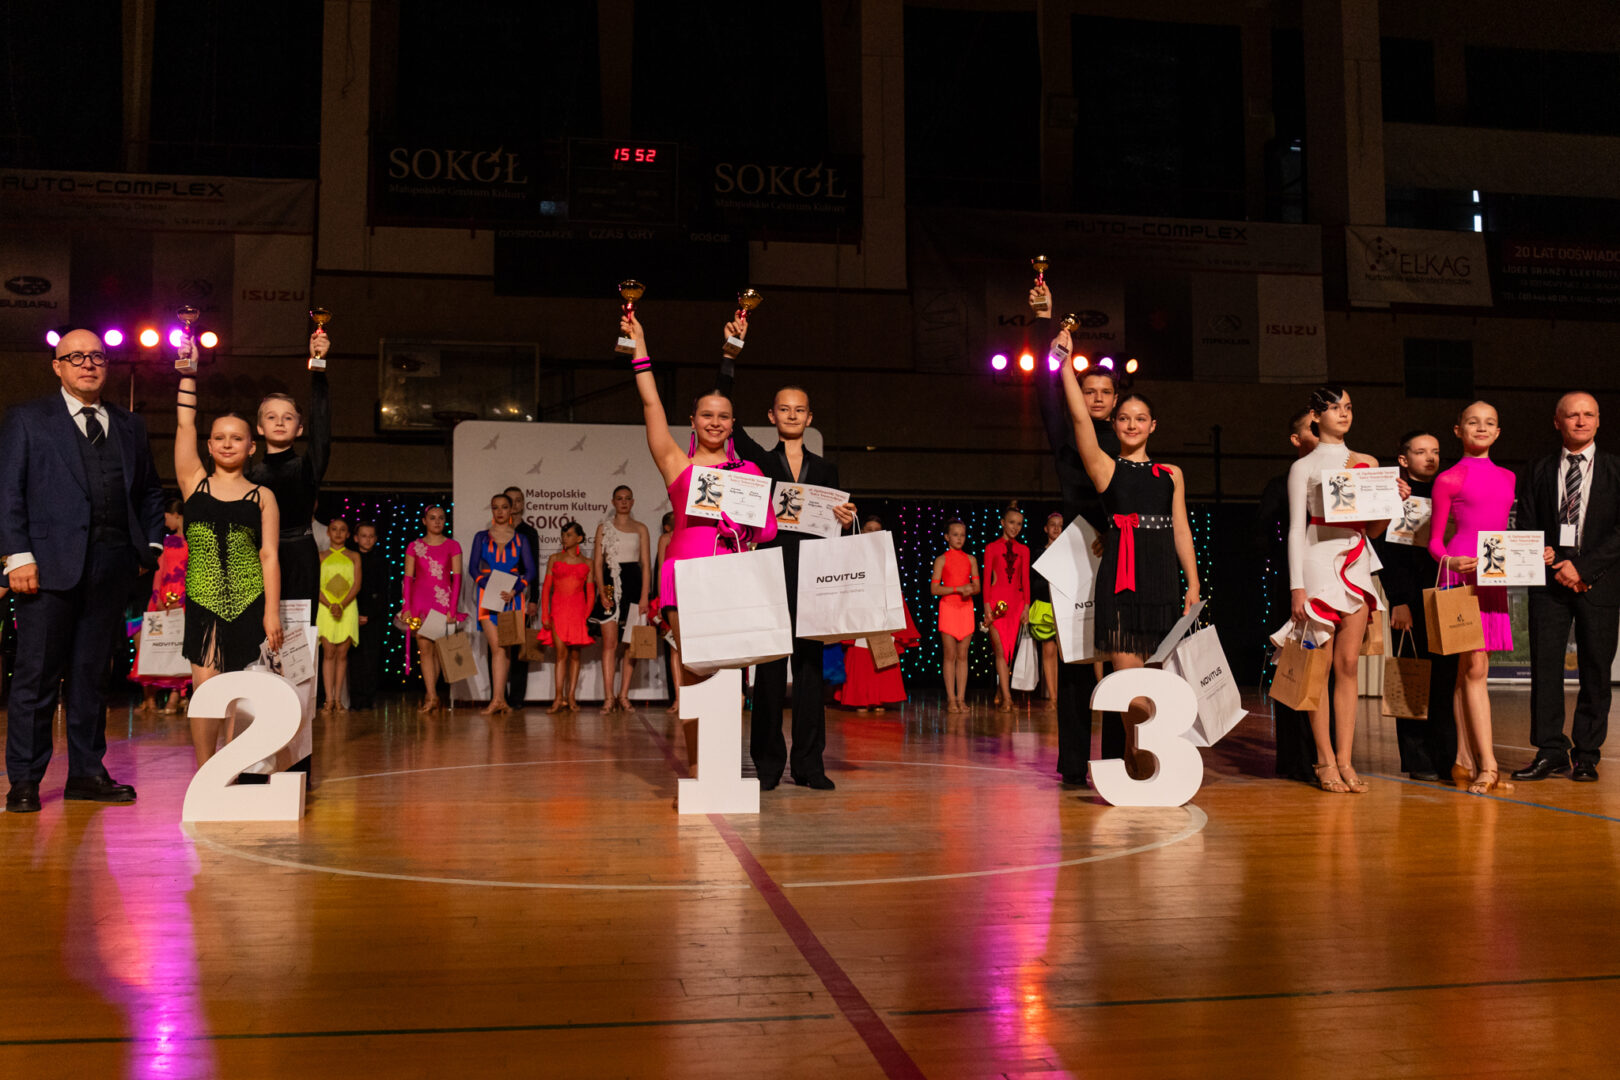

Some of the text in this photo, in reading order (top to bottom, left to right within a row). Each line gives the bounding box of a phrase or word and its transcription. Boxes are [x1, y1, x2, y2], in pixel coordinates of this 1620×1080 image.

[614, 147, 657, 162] 15 52
[2, 176, 224, 197] AUTO-COMPLEX
[588, 229, 624, 240] CZAS
[627, 229, 656, 240] GRY
[1065, 220, 1248, 240] AUTO-COMPLEX
[1514, 246, 1530, 258] 20
[1533, 246, 1555, 259] LAT
[1400, 253, 1470, 277] ELKAG
[242, 290, 305, 301] ISUZU
[1266, 324, 1317, 336] ISUZU
[526, 489, 586, 500] Małopolskie
[526, 502, 608, 513] Centrum Kultury
[816, 571, 866, 583] NOVITUS
[1200, 666, 1222, 687] NOVITUS
[678, 669, 760, 814] 1
[1088, 668, 1204, 807] 3
[182, 670, 304, 822] 2
